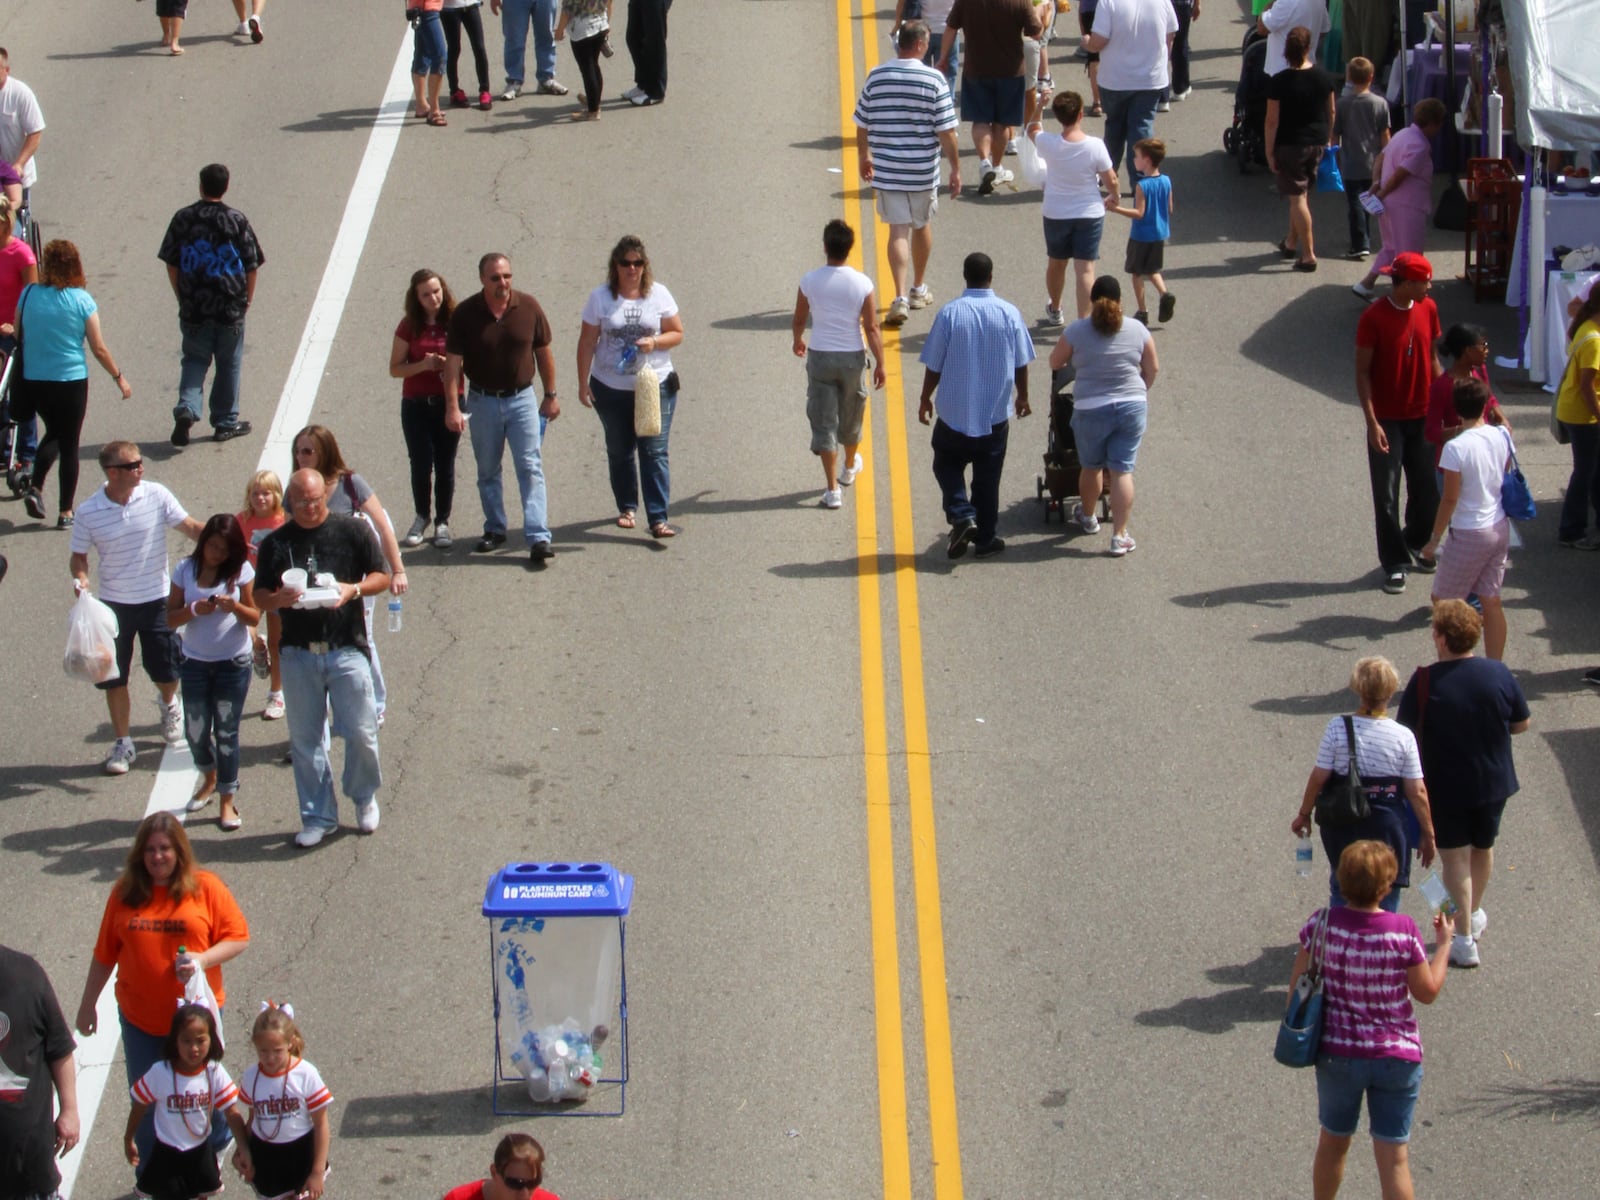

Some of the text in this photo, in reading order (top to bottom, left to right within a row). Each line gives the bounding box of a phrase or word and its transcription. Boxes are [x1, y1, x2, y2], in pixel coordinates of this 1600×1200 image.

[519, 884, 593, 893] PLASTIC BOTTLES
[520, 891, 567, 899] ALUMINUM
